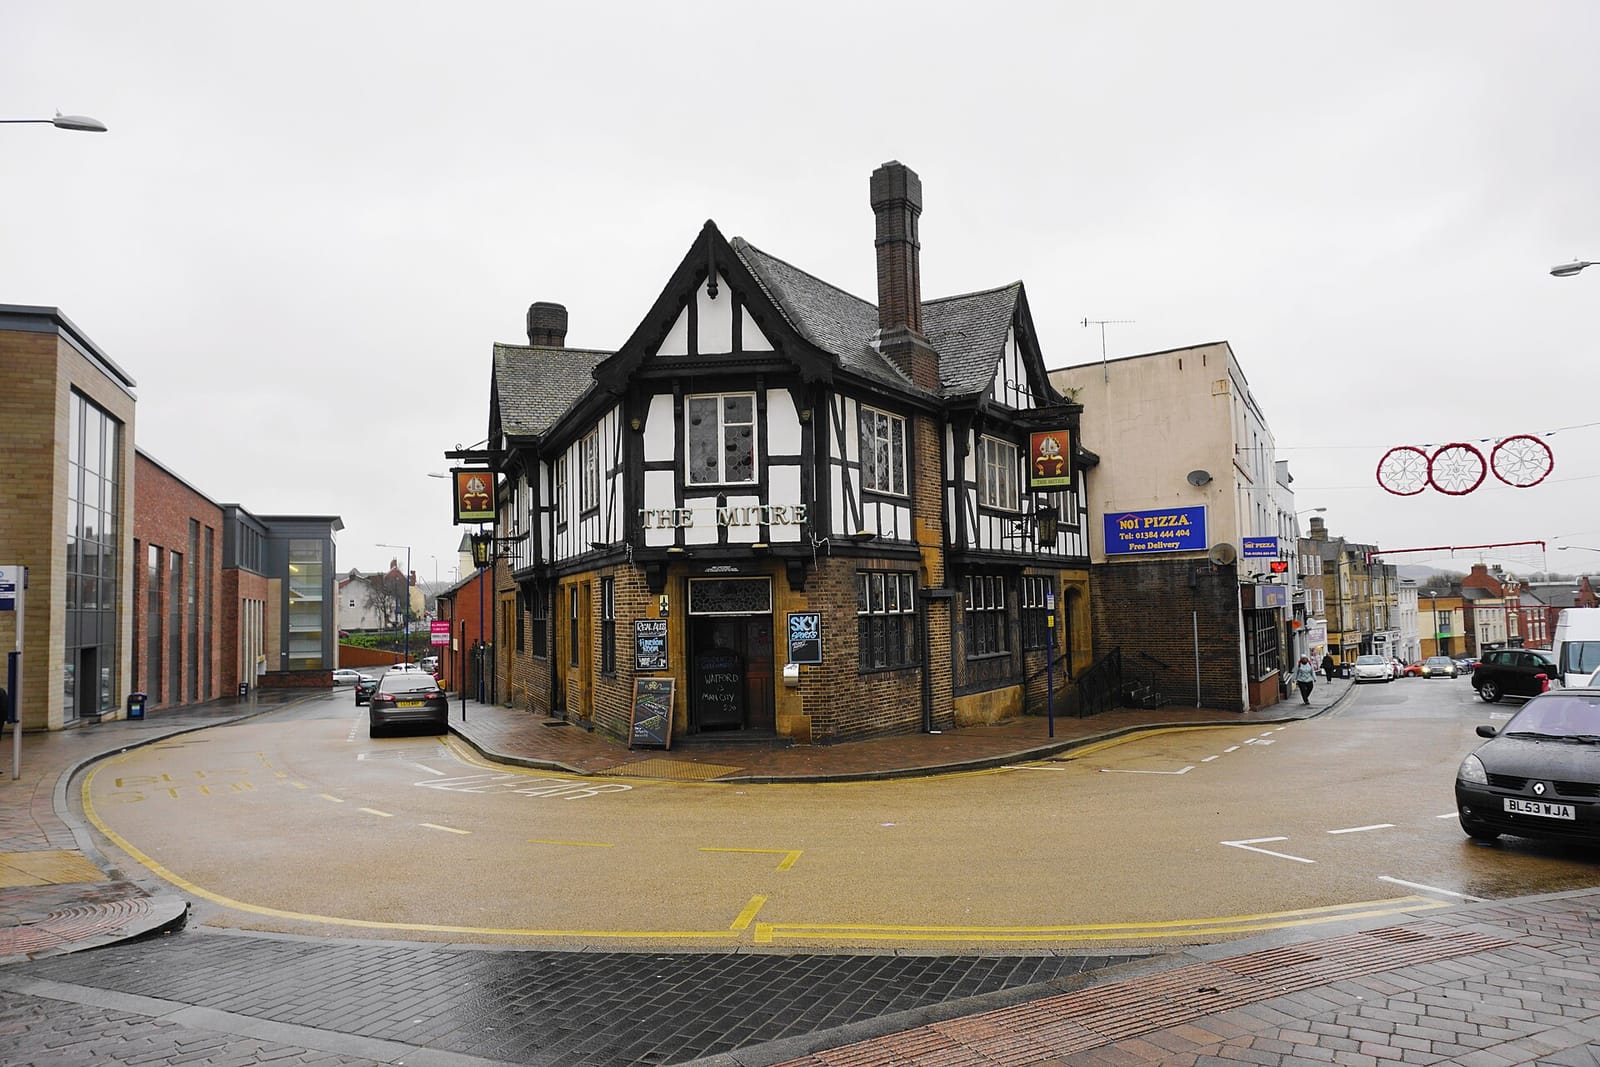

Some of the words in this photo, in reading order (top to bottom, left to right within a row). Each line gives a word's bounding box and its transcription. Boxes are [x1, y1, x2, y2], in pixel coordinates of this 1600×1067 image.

[639, 507, 694, 529] THE
[716, 504, 808, 527] MITRE
[1143, 514, 1190, 528] PIZZA
[1119, 532, 1134, 540] Tel:
[1135, 531, 1158, 539] 01384
[1159, 530, 1174, 538] 444
[1175, 529, 1190, 537] 404
[1147, 541, 1180, 549] Delivery
[790, 615, 818, 631] SKY
[704, 672, 739, 684] WATFORD
[719, 692, 735, 702] CITY
[413, 773, 633, 801] CLEAR
[1509, 800, 1541, 813] BL53
[1544, 804, 1569, 817] WJA
